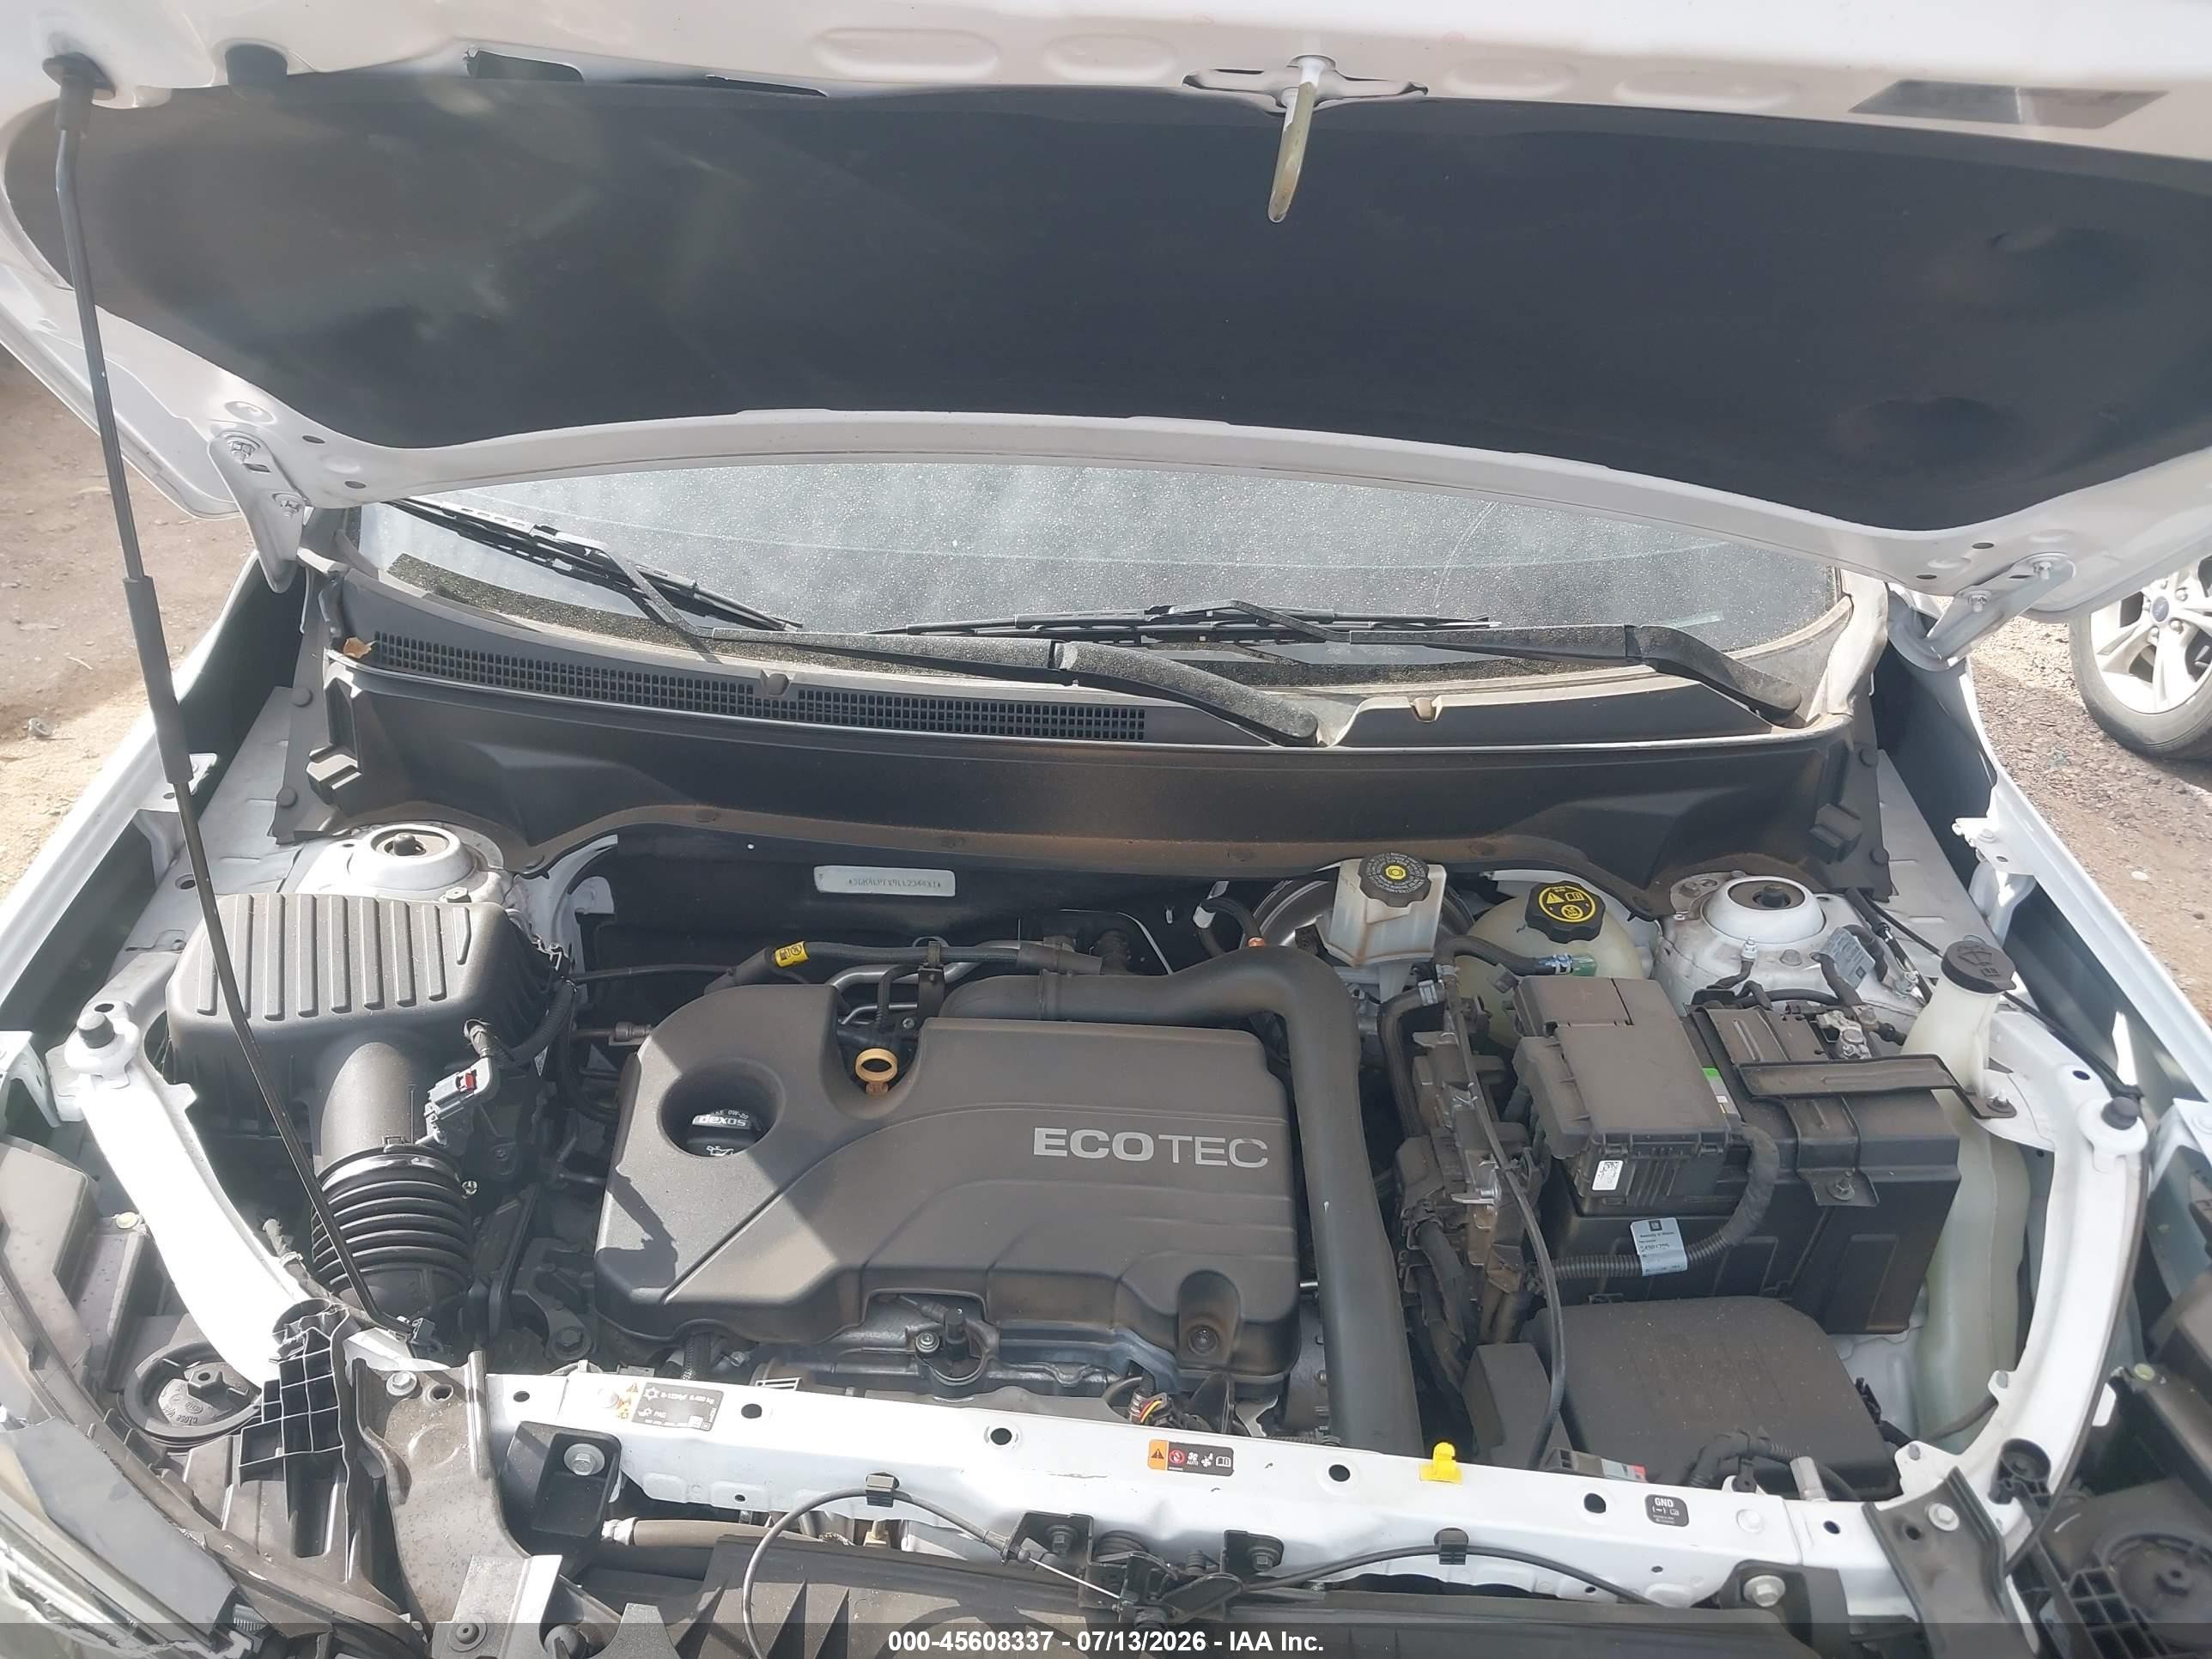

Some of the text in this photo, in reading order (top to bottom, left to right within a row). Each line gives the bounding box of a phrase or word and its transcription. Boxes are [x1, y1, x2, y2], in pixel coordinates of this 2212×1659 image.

[699, 1115, 748, 1127] dexos
[1033, 1127, 1268, 1168] ECOTEC
[1654, 1497, 1674, 1508] GND
